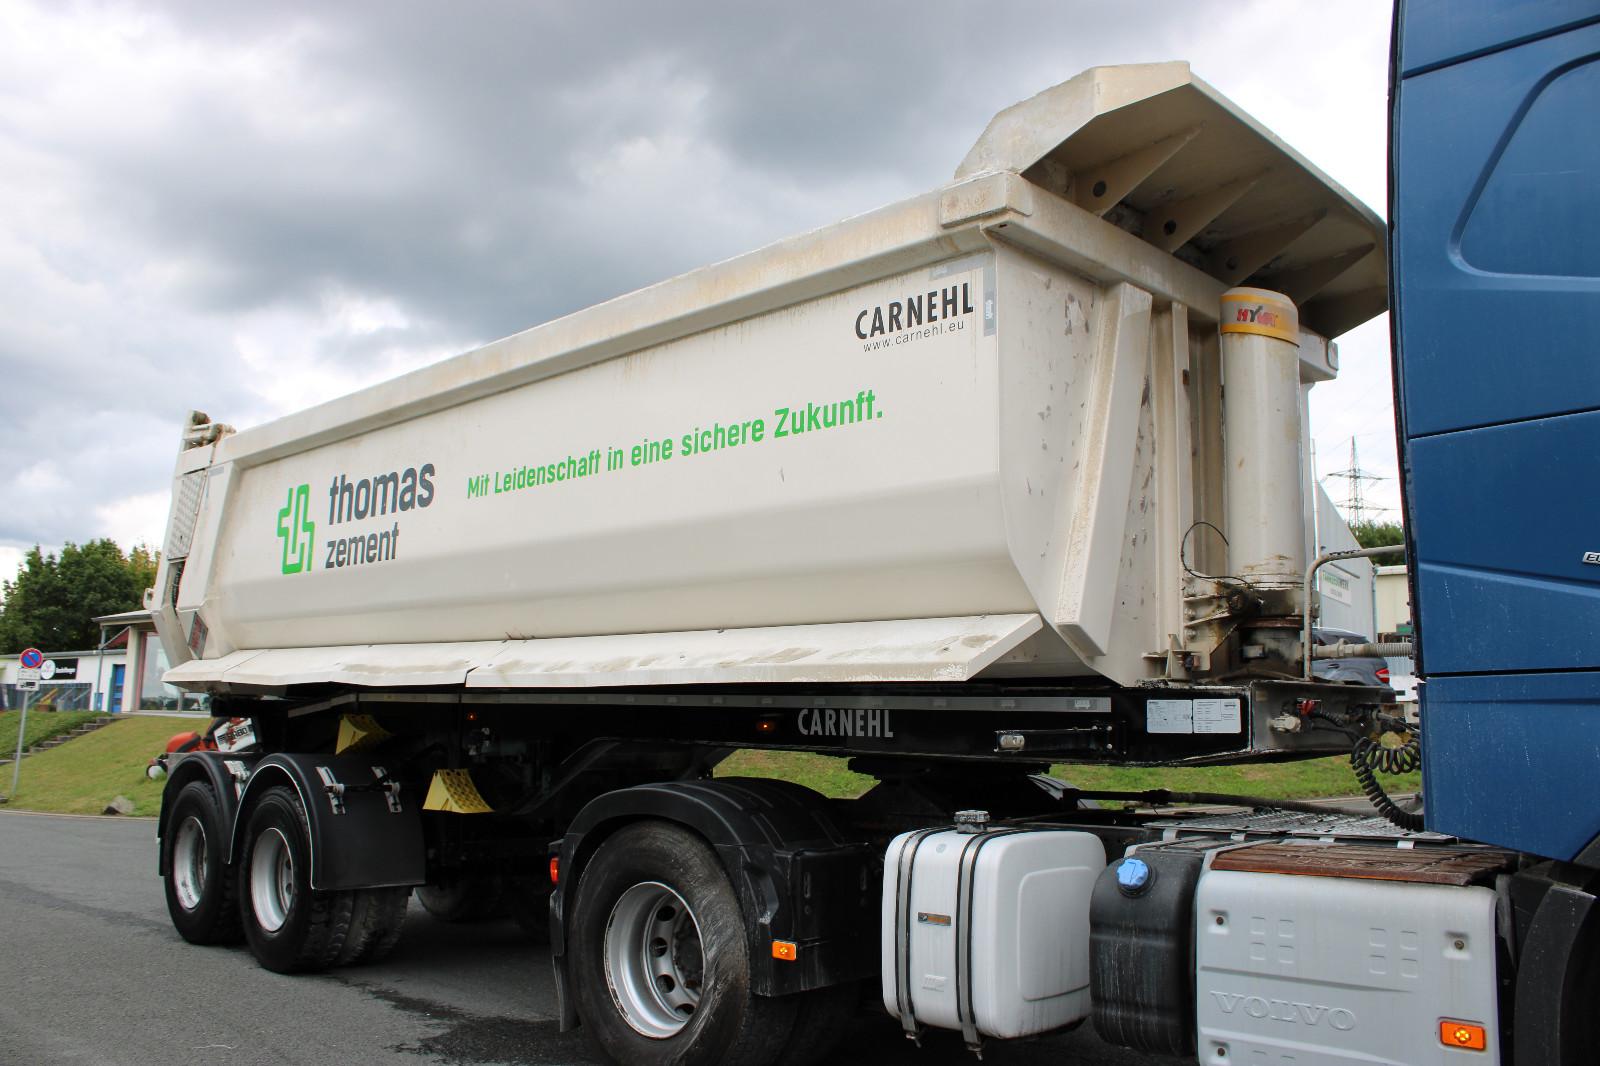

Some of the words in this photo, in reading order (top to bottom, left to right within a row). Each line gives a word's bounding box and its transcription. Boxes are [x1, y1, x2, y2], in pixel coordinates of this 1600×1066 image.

[855, 282, 974, 340] CARNEHL
[863, 319, 965, 353] www.carnehl.eu
[467, 475, 491, 499] Mit
[494, 449, 601, 495] Leidenschaft
[607, 447, 624, 471] in
[631, 437, 674, 467] eine
[681, 417, 765, 457] sichere
[774, 389, 884, 439] Zukunft.
[329, 463, 435, 525] thomas
[325, 522, 399, 569] zement
[797, 708, 894, 738] CARNEHL
[1209, 990, 1357, 1031] VOLVO
